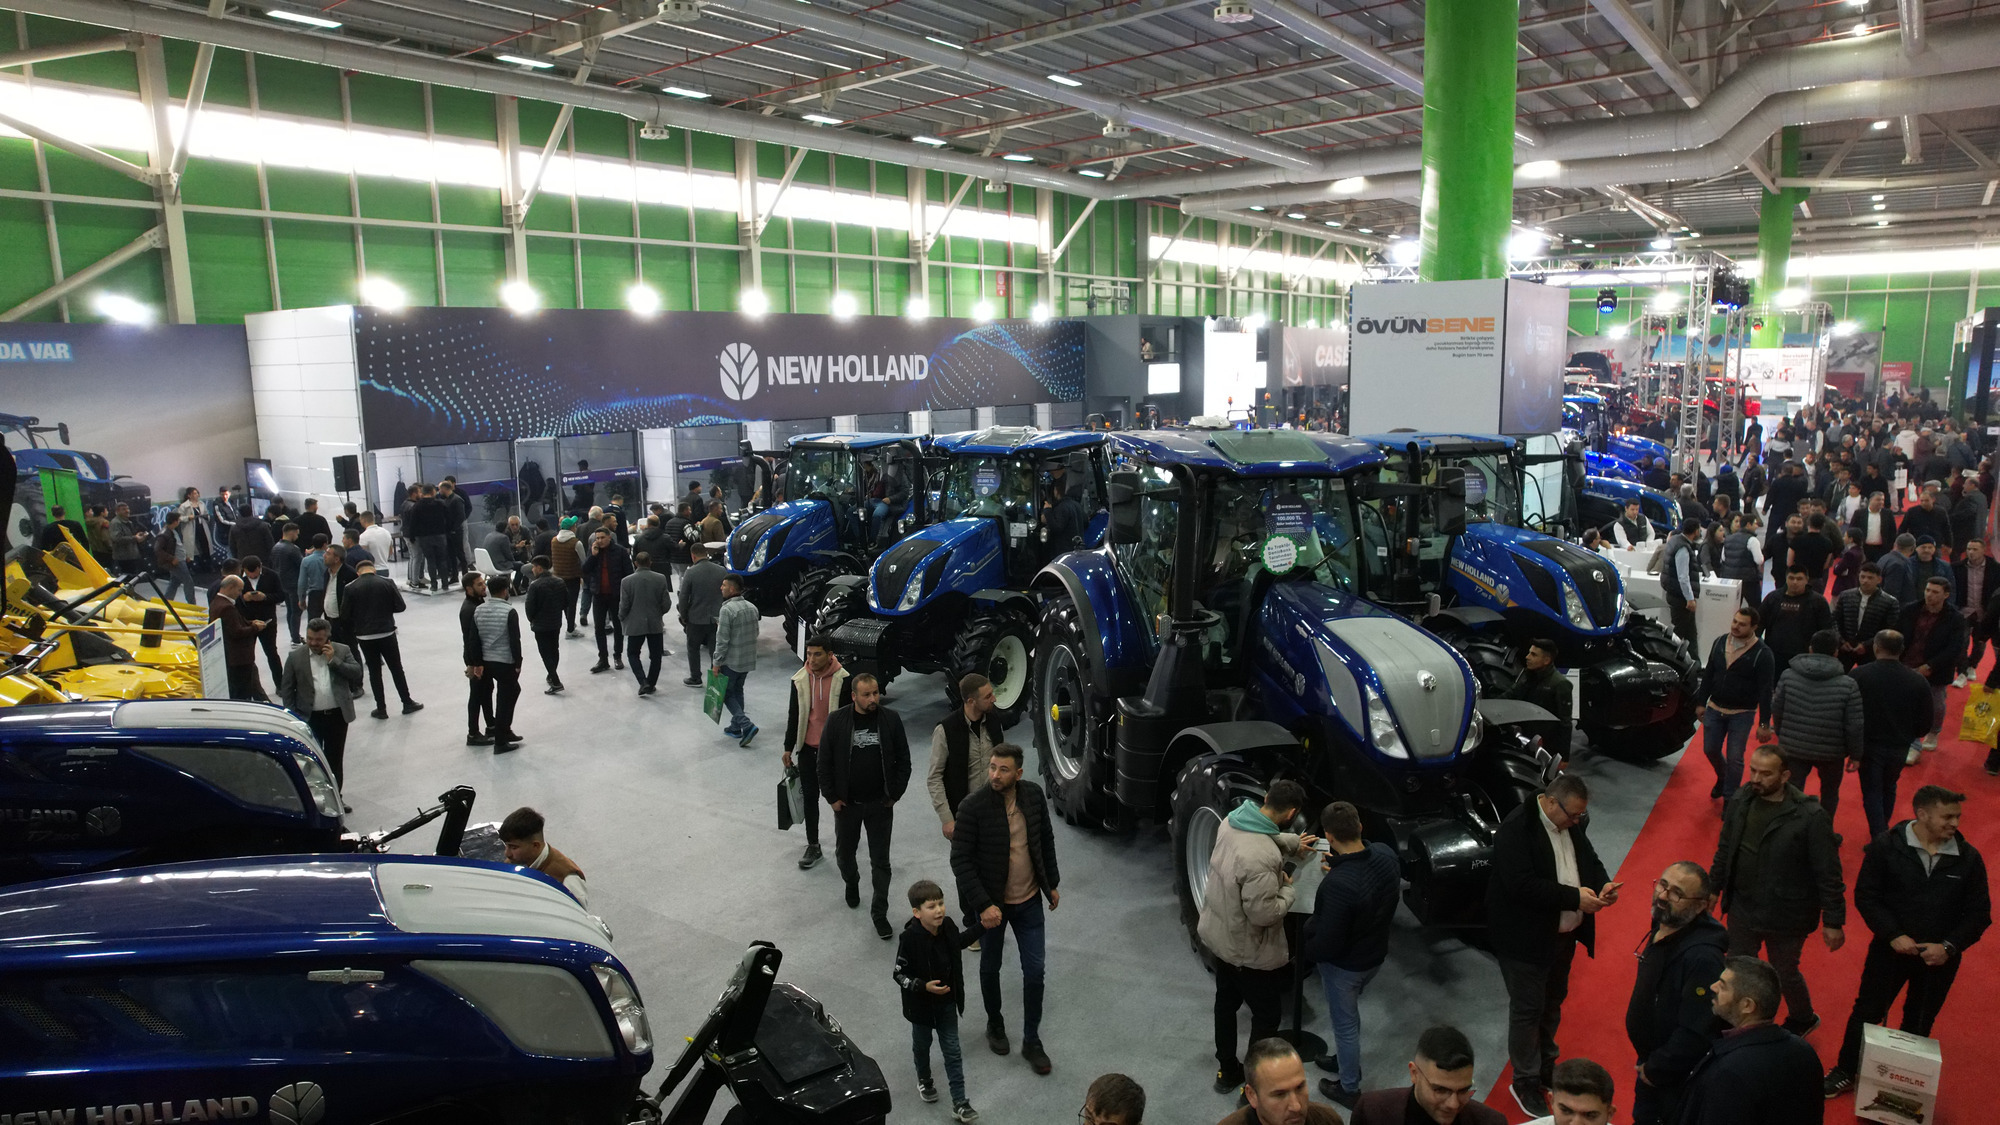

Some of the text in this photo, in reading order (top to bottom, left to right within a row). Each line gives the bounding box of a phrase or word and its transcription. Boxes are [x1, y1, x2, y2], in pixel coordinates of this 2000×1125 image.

[28, 343, 70, 359] VAR
[767, 354, 929, 385] NEW HOLLAND
[1451, 557, 1495, 587] NEW HOLLAND
[86, 1096, 259, 1125] HOLLAND
